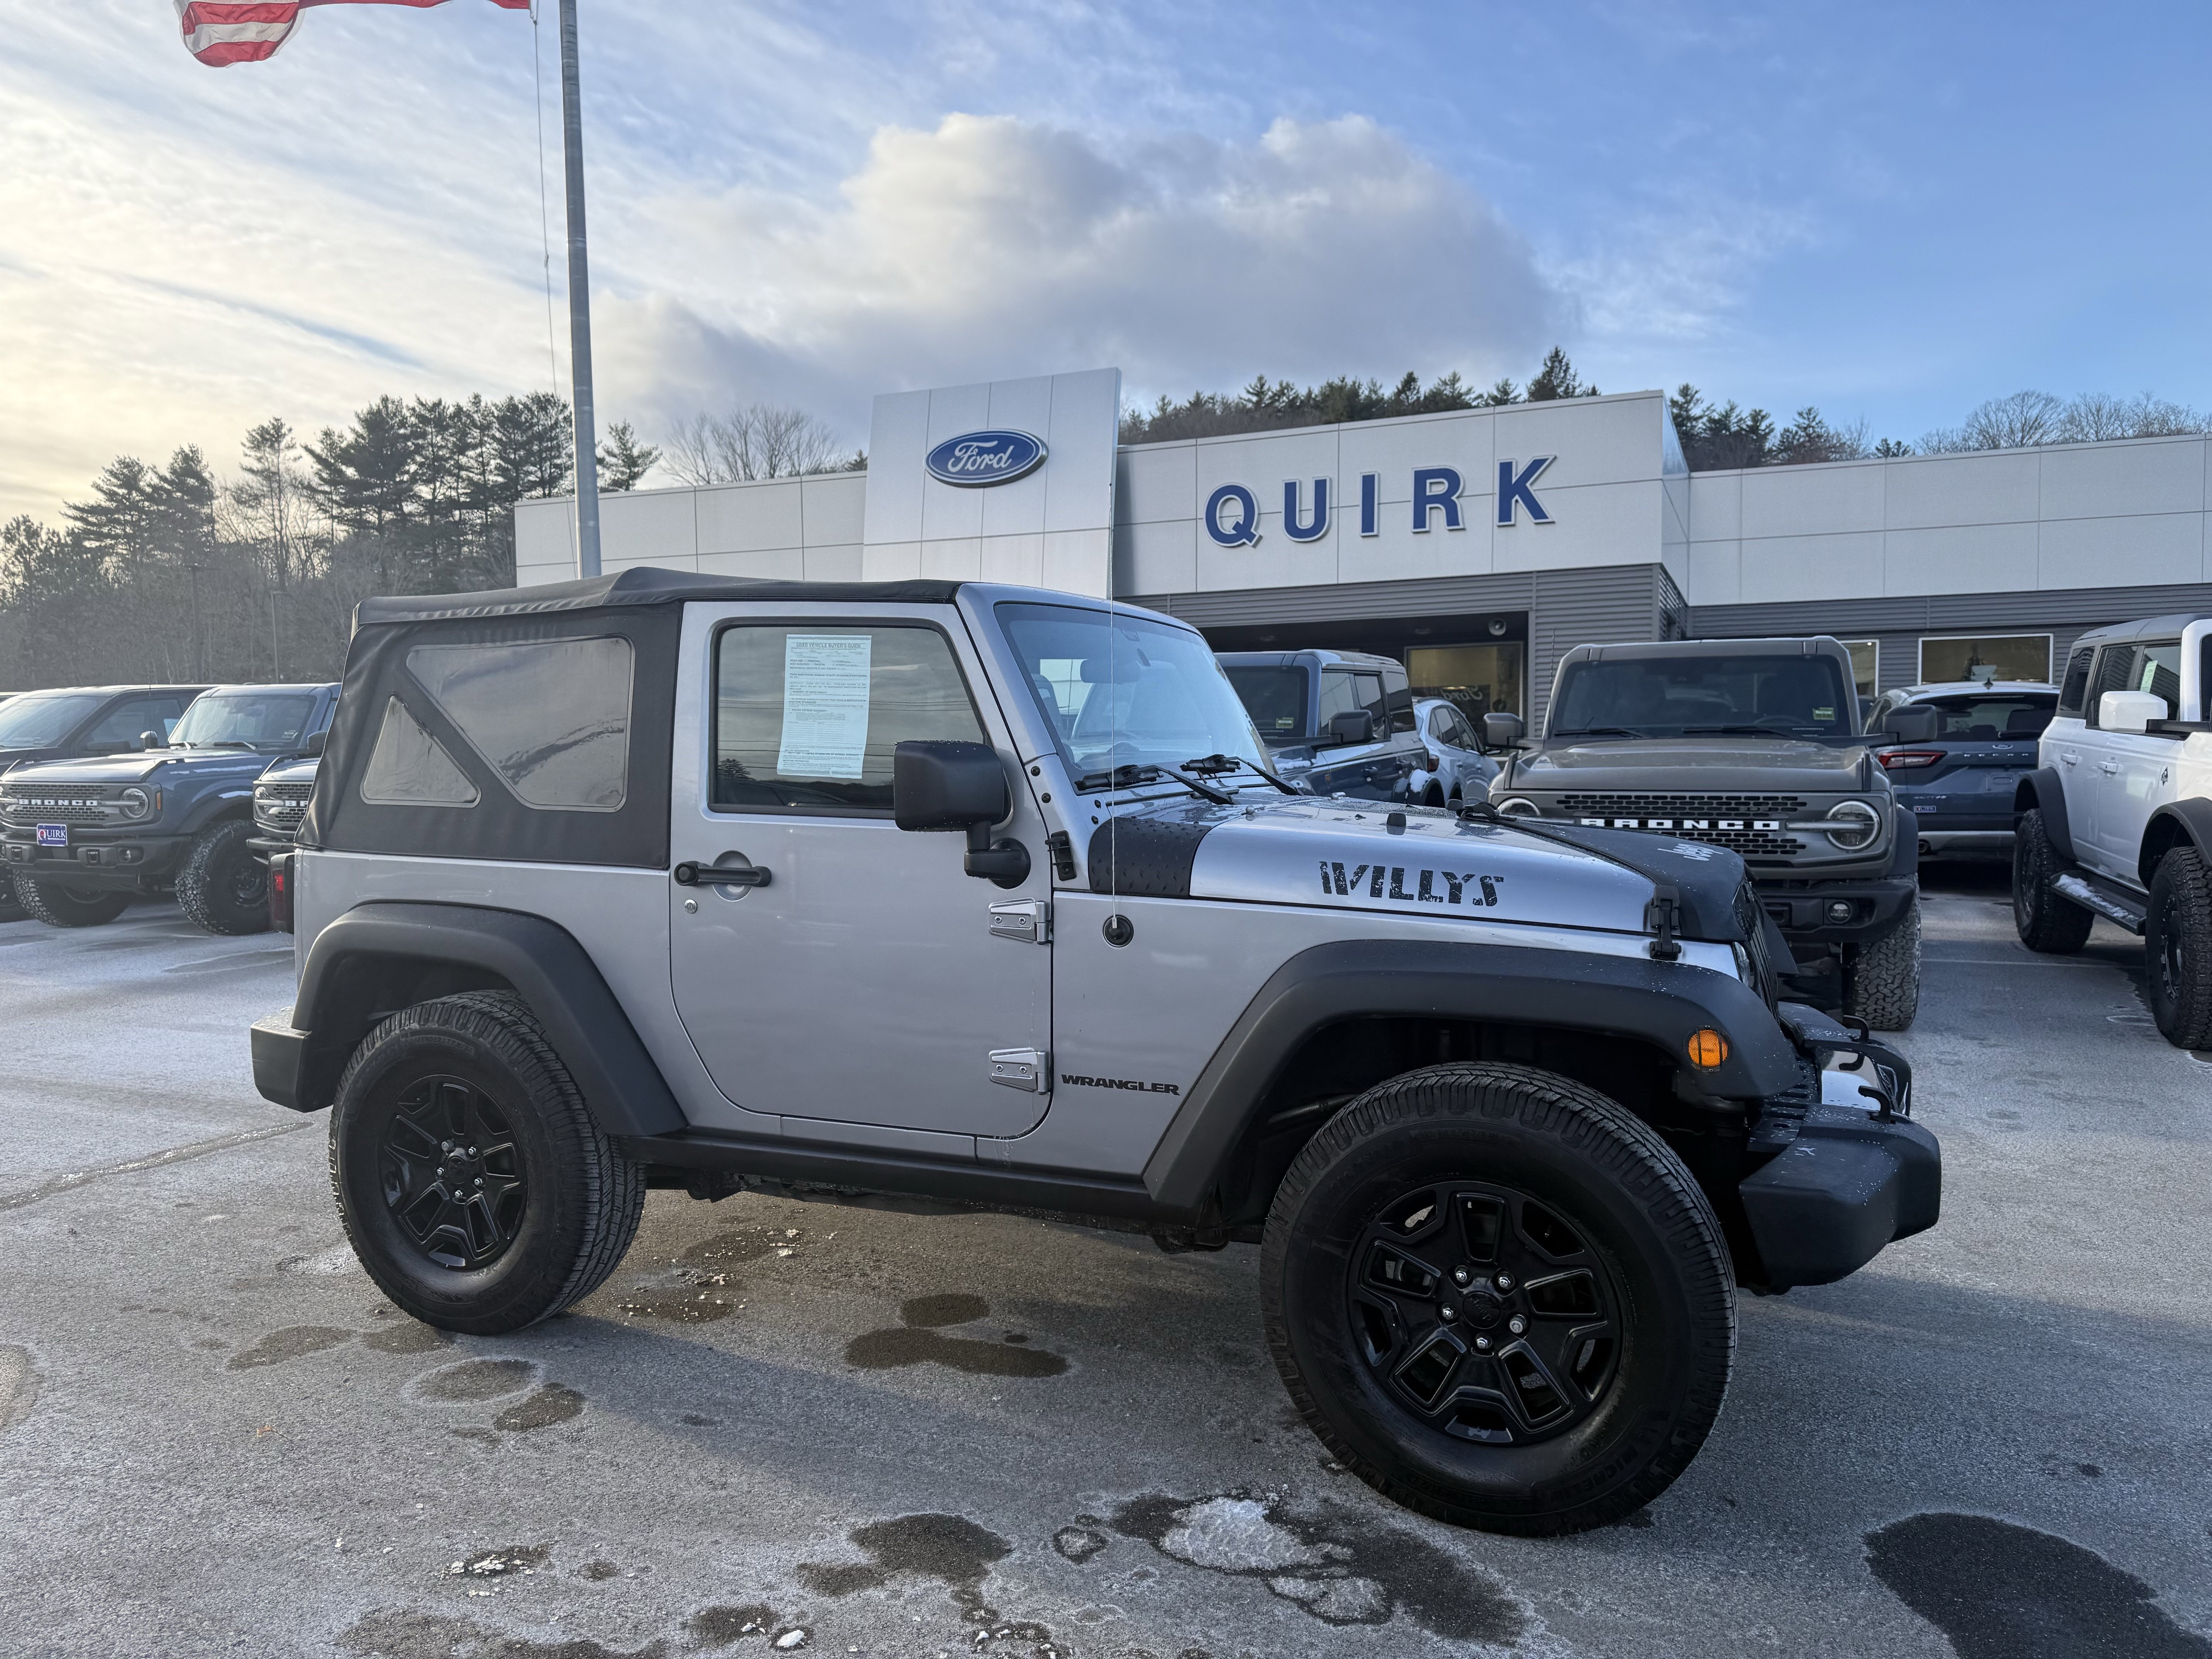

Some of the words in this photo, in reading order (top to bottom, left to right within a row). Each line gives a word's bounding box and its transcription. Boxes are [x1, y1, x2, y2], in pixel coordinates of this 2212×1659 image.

[948, 440, 1014, 472] Ford
[1204, 454, 1556, 548] QUIRK
[38, 829, 65, 840] QUIRK
[1581, 818, 1779, 830] BRONCO
[1657, 843, 1723, 861] Jeep
[1319, 861, 1504, 907] WILLYS
[1061, 1074, 1180, 1096] WRANGLER
